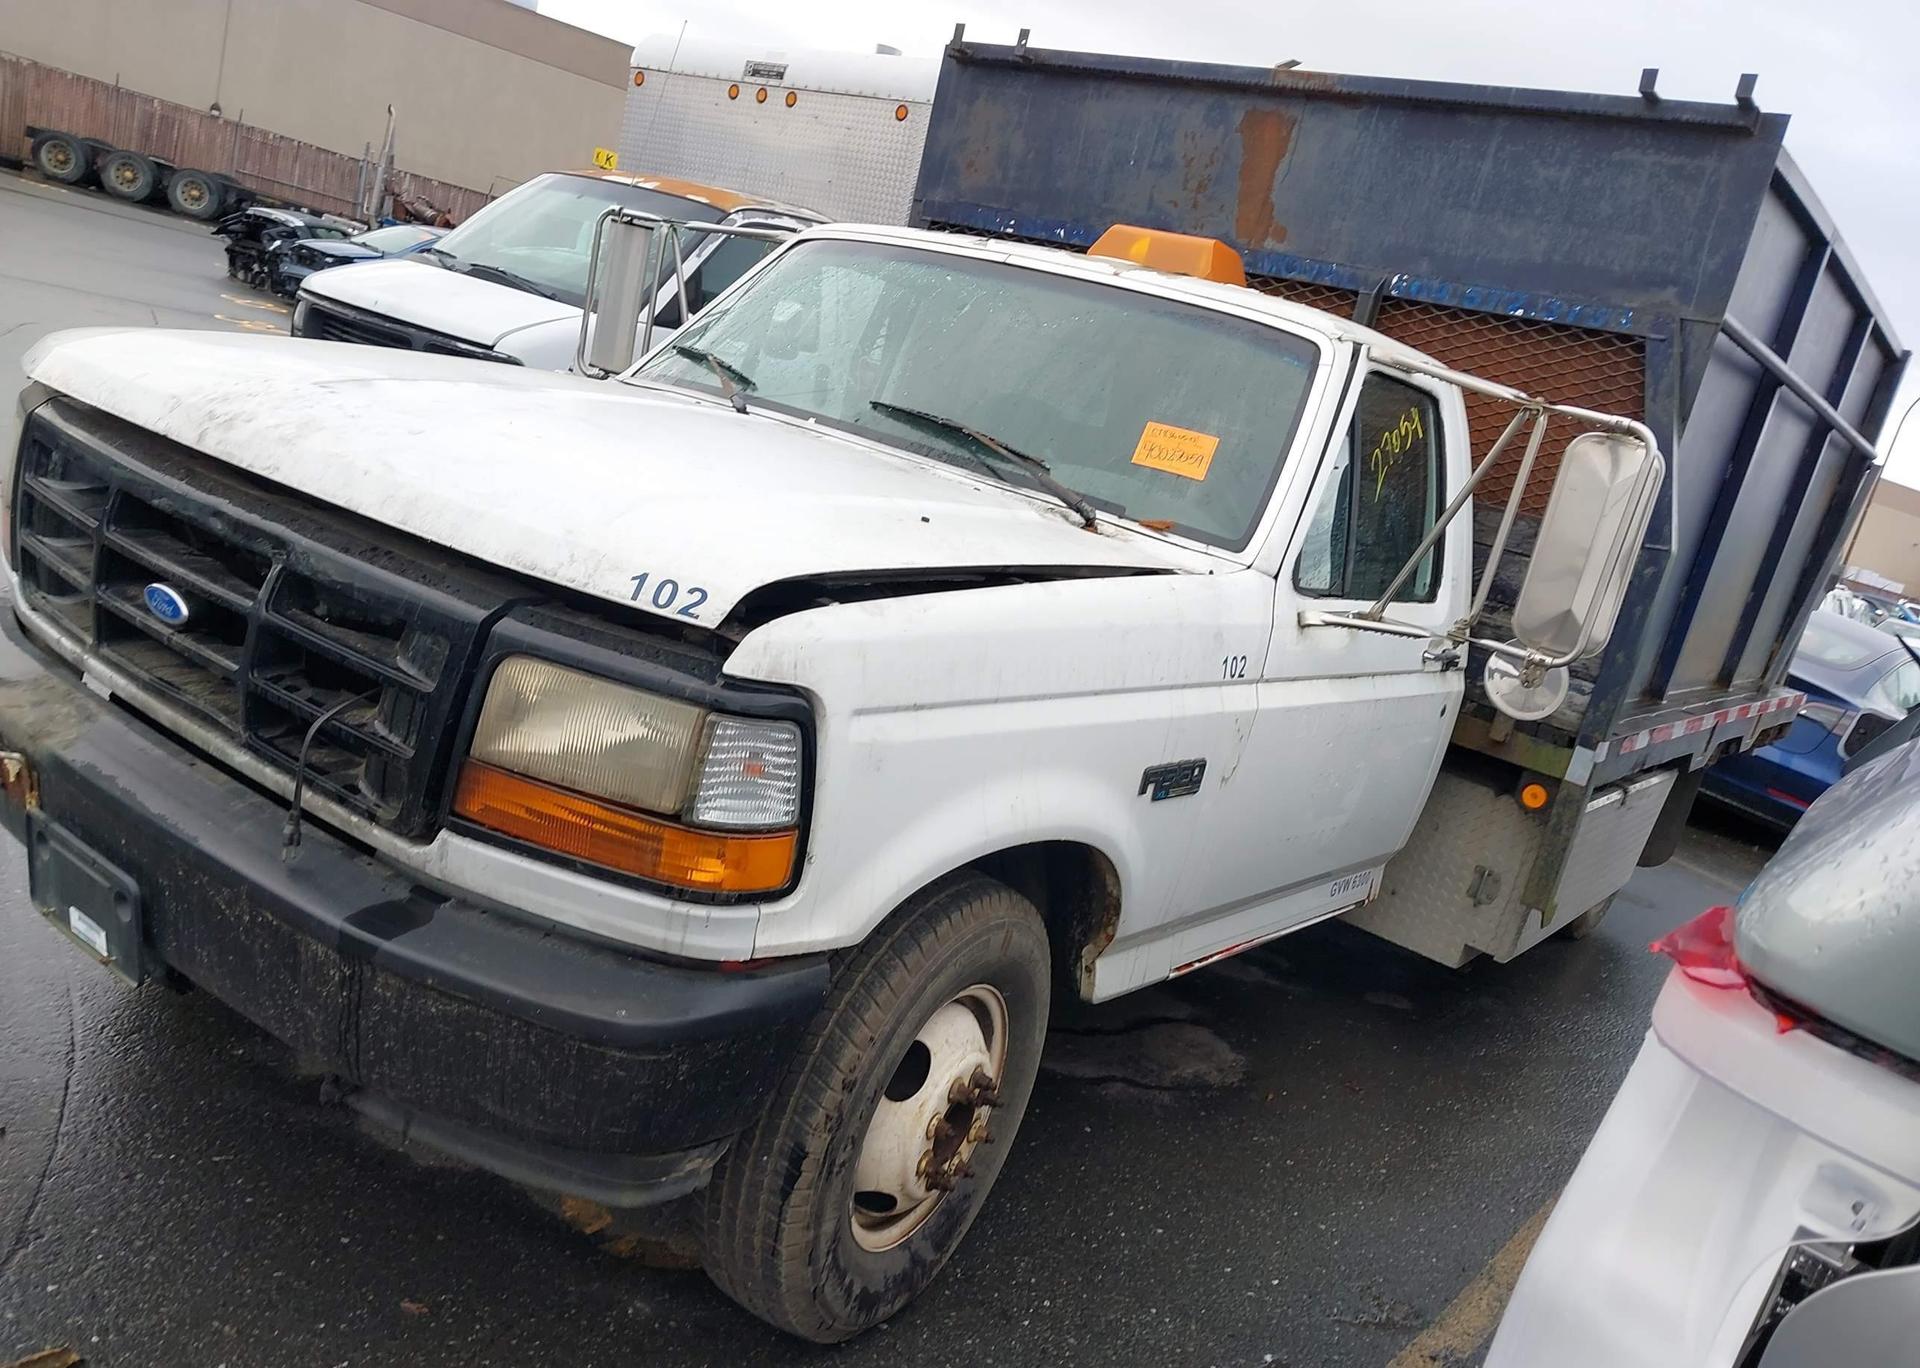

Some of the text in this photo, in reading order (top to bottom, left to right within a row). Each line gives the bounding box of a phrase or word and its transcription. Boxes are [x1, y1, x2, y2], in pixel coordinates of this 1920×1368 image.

[630, 571, 709, 620] 102
[1222, 654, 1248, 680] 102
[1330, 876, 1353, 898] GVW
